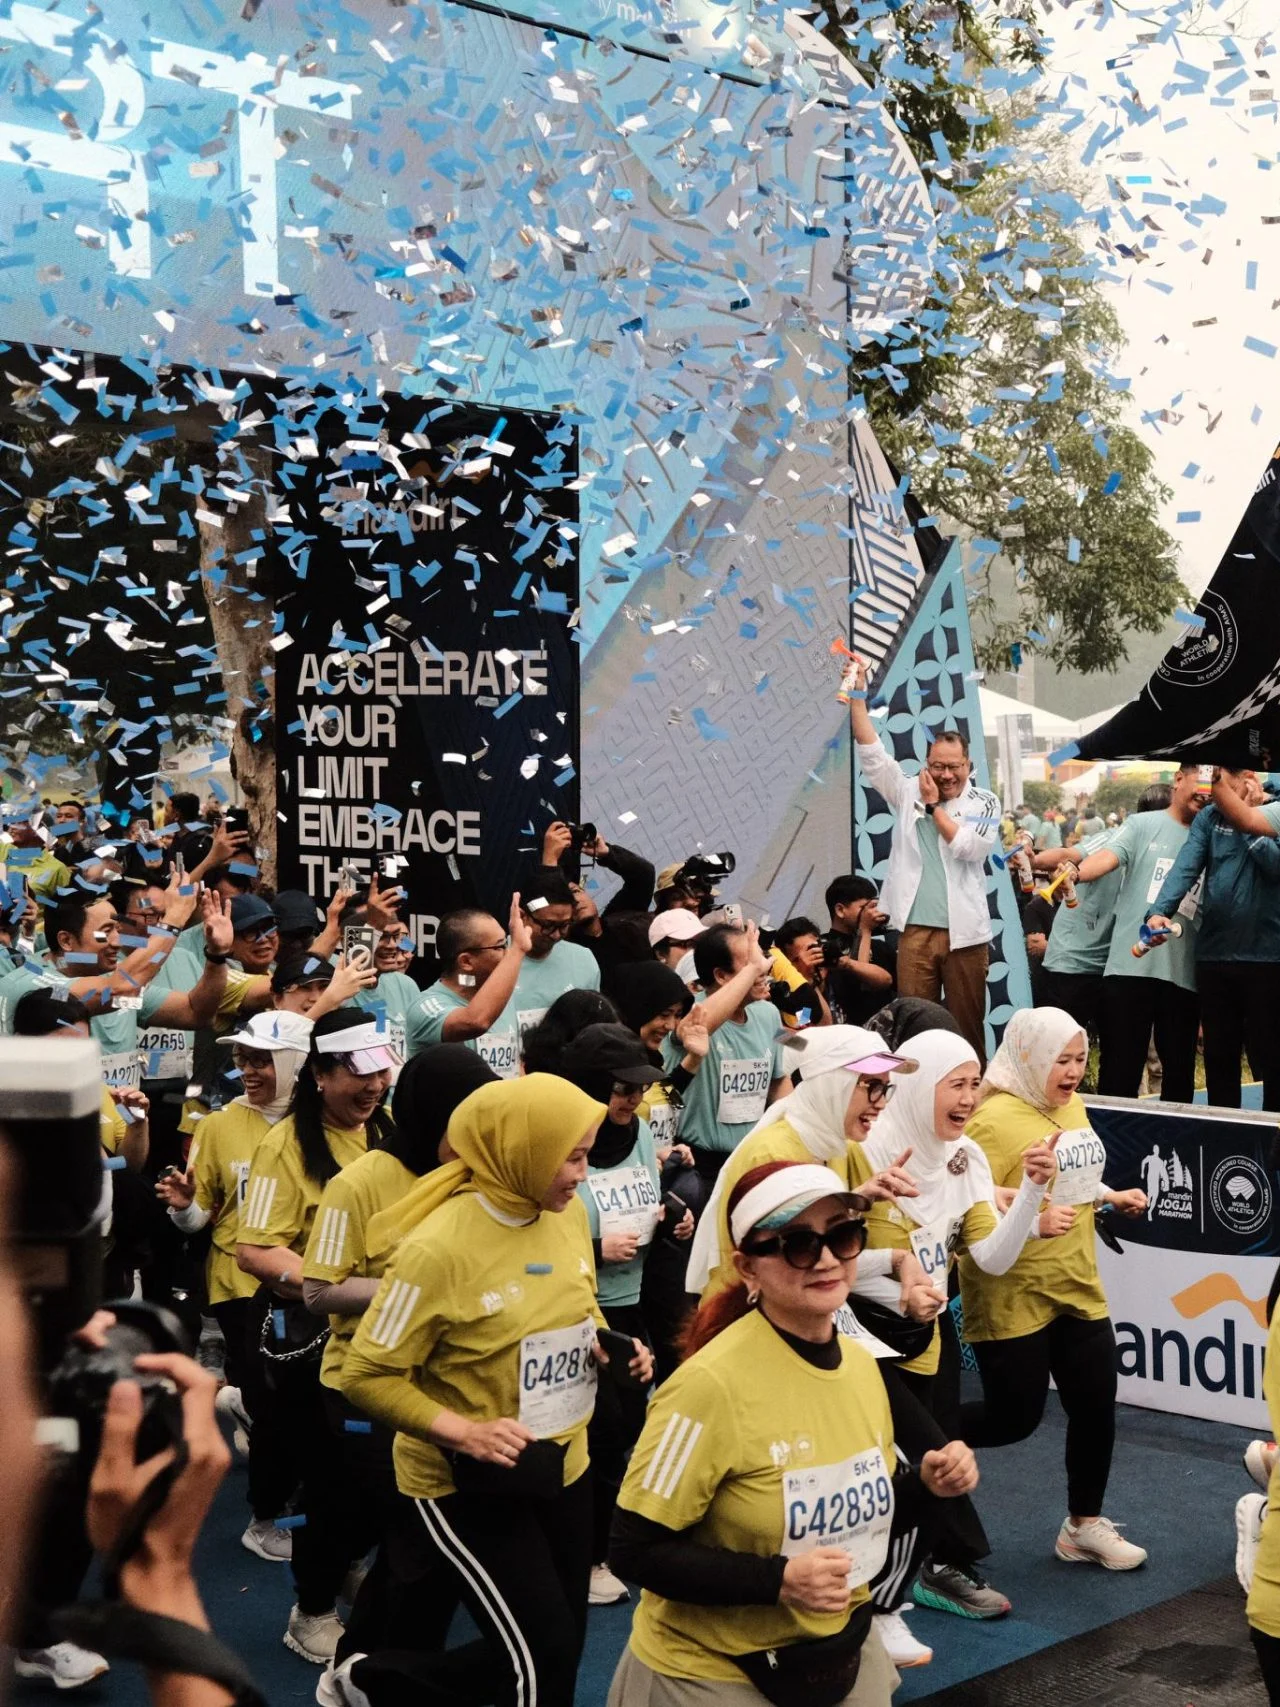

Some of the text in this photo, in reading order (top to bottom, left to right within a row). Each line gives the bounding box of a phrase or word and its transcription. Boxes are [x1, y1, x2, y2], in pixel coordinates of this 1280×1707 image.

[1179, 648, 1210, 667] ATHLET
[1181, 639, 1208, 658] WORLD
[296, 649, 548, 696] ACCELERATE
[297, 704, 396, 748] YOUR
[297, 755, 389, 800] LIMIT
[298, 804, 481, 856] EMBRACE
[722, 1070, 769, 1094] C42978
[1056, 1140, 1105, 1172] C42723
[595, 1181, 657, 1212] C41169
[1157, 1198, 1193, 1213] JOGJA
[1167, 1192, 1193, 1201] mandiri
[1158, 1209, 1193, 1220] MARATHON
[1228, 1206, 1255, 1215] ATHLETICS
[854, 1455, 881, 1477] 5K-F
[788, 1475, 891, 1541] C42839
